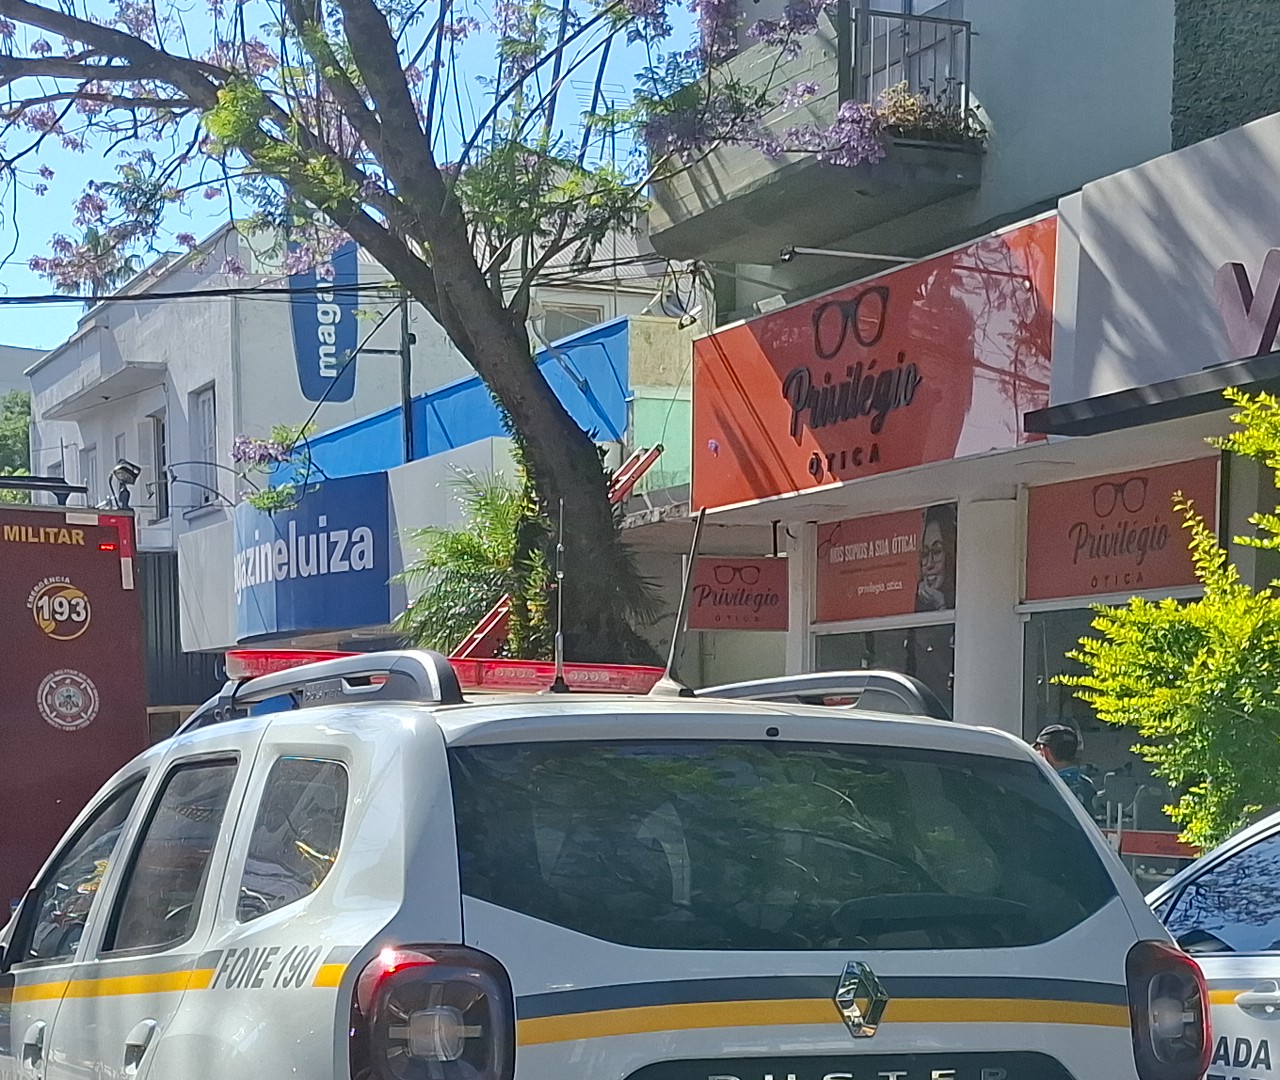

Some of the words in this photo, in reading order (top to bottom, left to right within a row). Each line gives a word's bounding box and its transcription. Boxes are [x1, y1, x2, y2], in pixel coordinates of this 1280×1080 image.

[782, 352, 923, 440] Privilégio
[4, 524, 85, 546] MILITAR
[26, 575, 71, 609] EMERGÊNCIA
[37, 595, 87, 622] 193
[211, 946, 281, 989] FONE
[272, 945, 323, 988] 190
[1211, 1036, 1272, 1071] ADA
